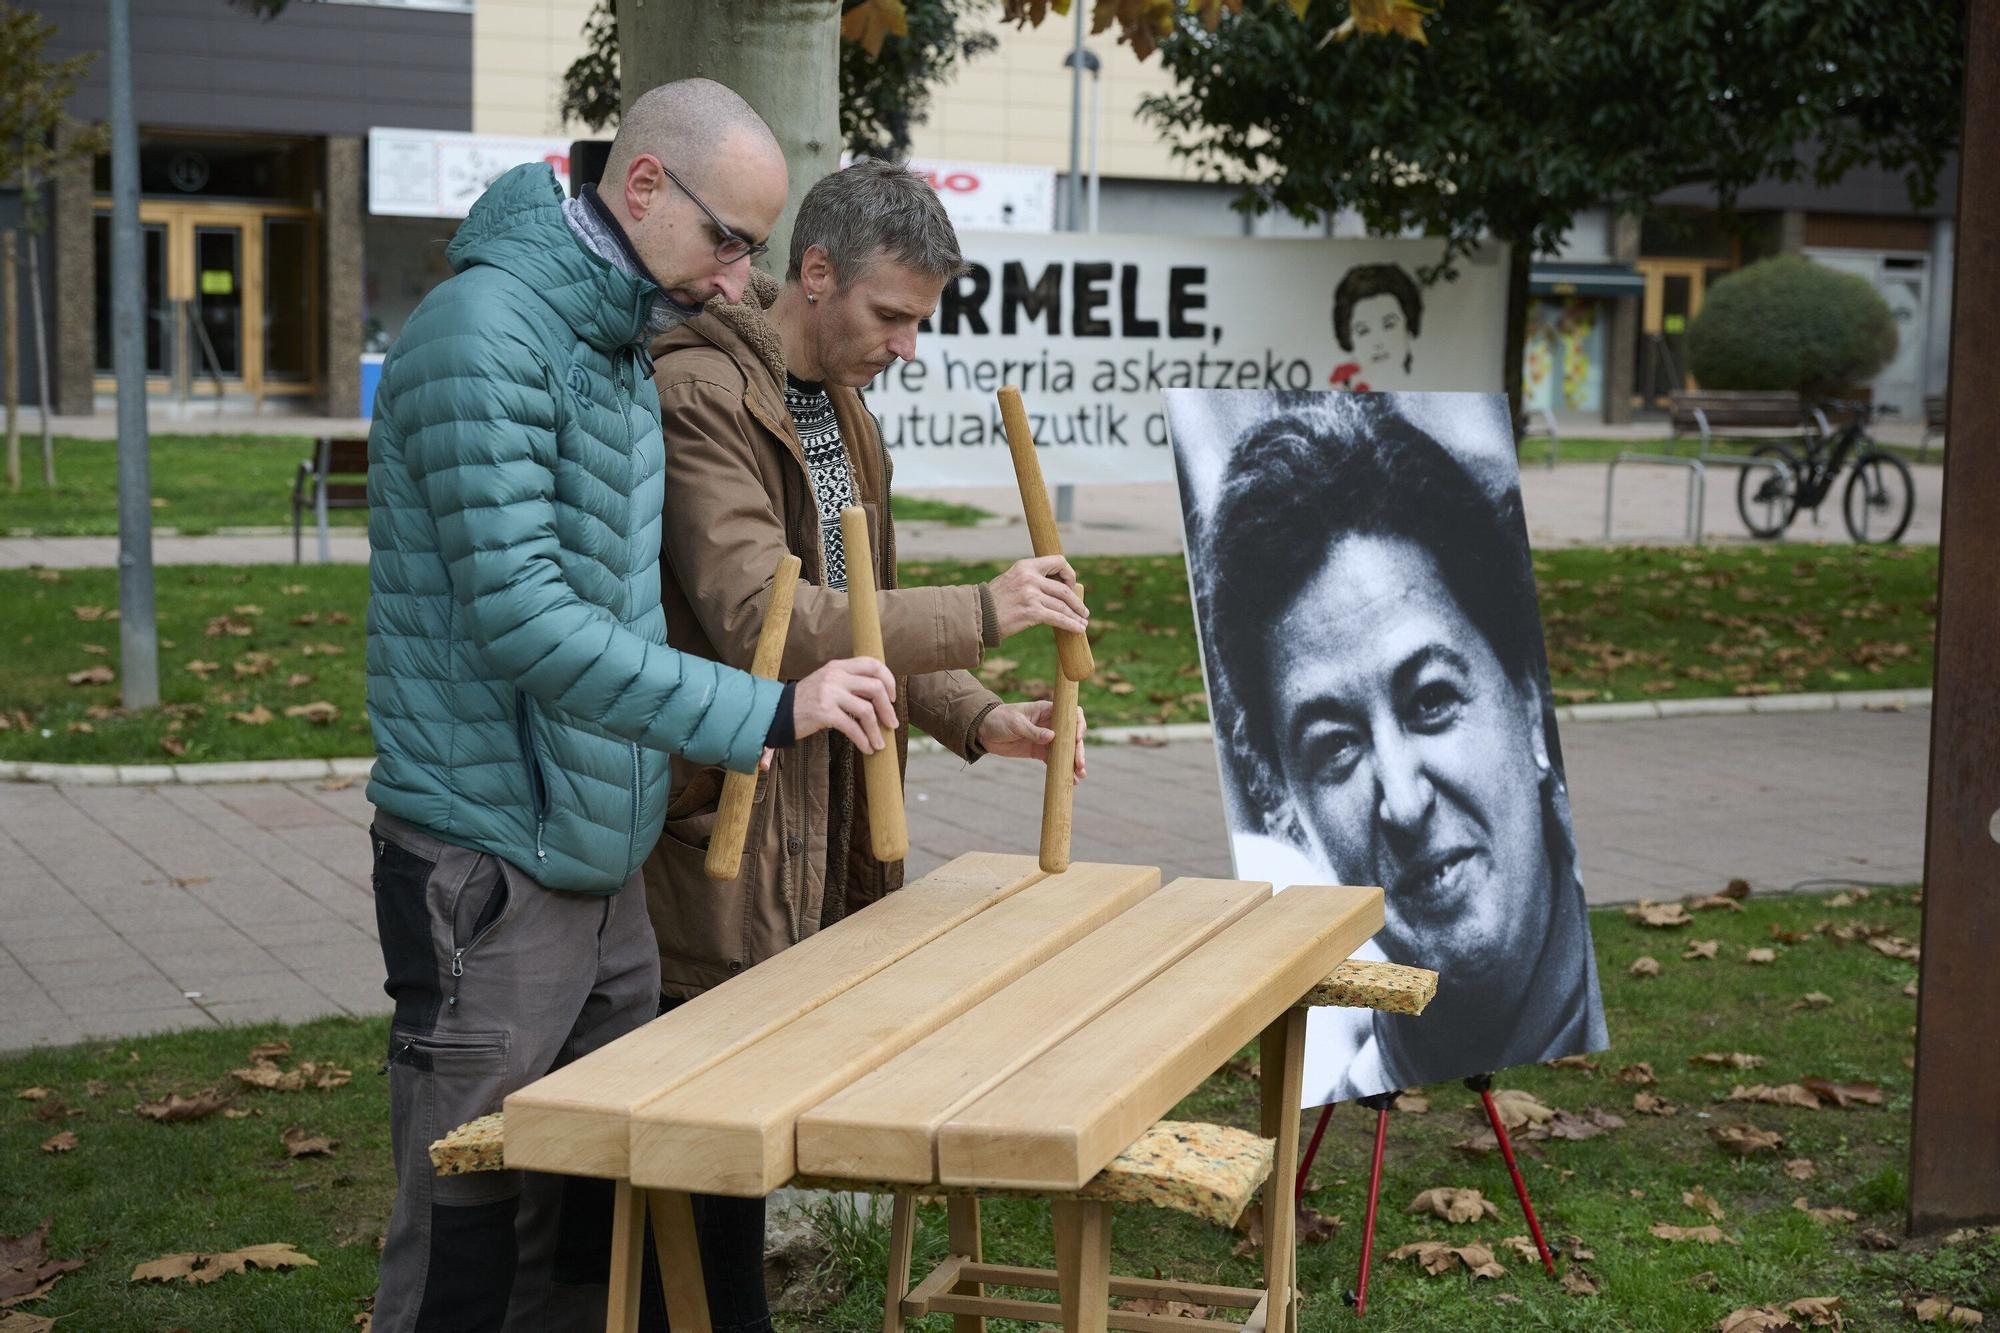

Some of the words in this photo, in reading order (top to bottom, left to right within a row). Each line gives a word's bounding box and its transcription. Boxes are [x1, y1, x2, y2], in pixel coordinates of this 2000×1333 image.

[918, 261, 1222, 345] RMELE,
[943, 349, 1074, 393] herria
[1092, 349, 1312, 392] askatzeko
[1030, 404, 1128, 447] zutik
